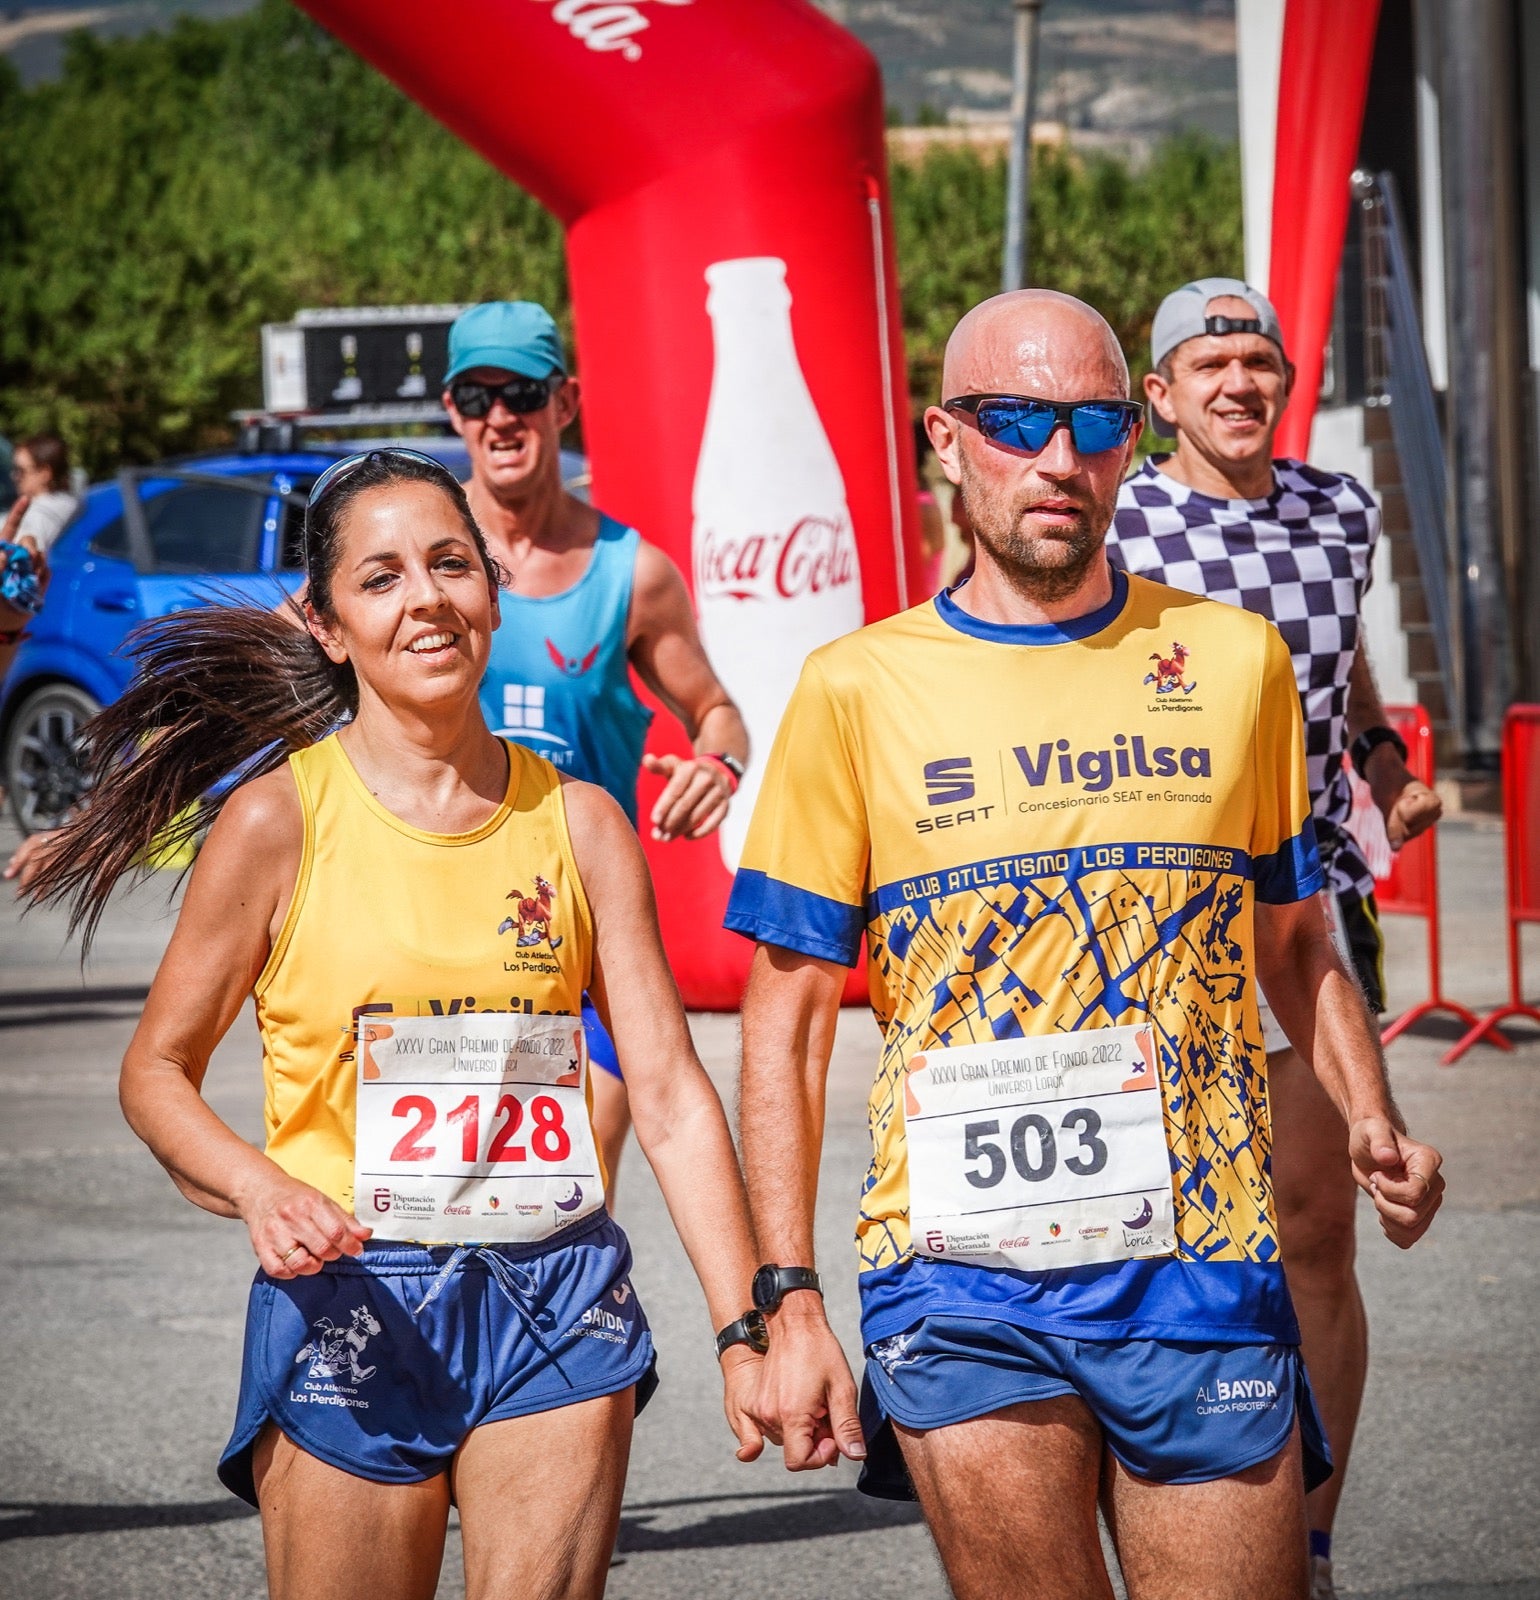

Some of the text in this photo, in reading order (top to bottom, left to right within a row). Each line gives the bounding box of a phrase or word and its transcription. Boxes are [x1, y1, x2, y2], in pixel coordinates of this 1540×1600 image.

[1161, 704, 1203, 713] Perdigones
[1012, 733, 1212, 792] Vigilsa
[1018, 790, 1212, 814] Concesionario SEAT en Granada
[915, 805, 995, 834] SEAT
[902, 846, 1234, 902] CLUB ATLETISMO LOS PERDIGONES
[515, 951, 530, 959] Club
[503, 961, 520, 972] Los
[395, 1038, 424, 1055] XXXV
[929, 1065, 957, 1085] XXXV
[1092, 1042, 1122, 1064] 2022
[389, 1093, 571, 1163] 2128
[964, 1107, 1109, 1190] 503
[393, 1193, 436, 1203] Diputación
[392, 1203, 435, 1212] de Granada
[946, 1232, 990, 1243] Diputación
[957, 1240, 990, 1250] Granada
[304, 1382, 358, 1395] Club Atletismo
[1195, 1379, 1277, 1403] AL BAYDA
[290, 1390, 370, 1409] Los Perdigones
